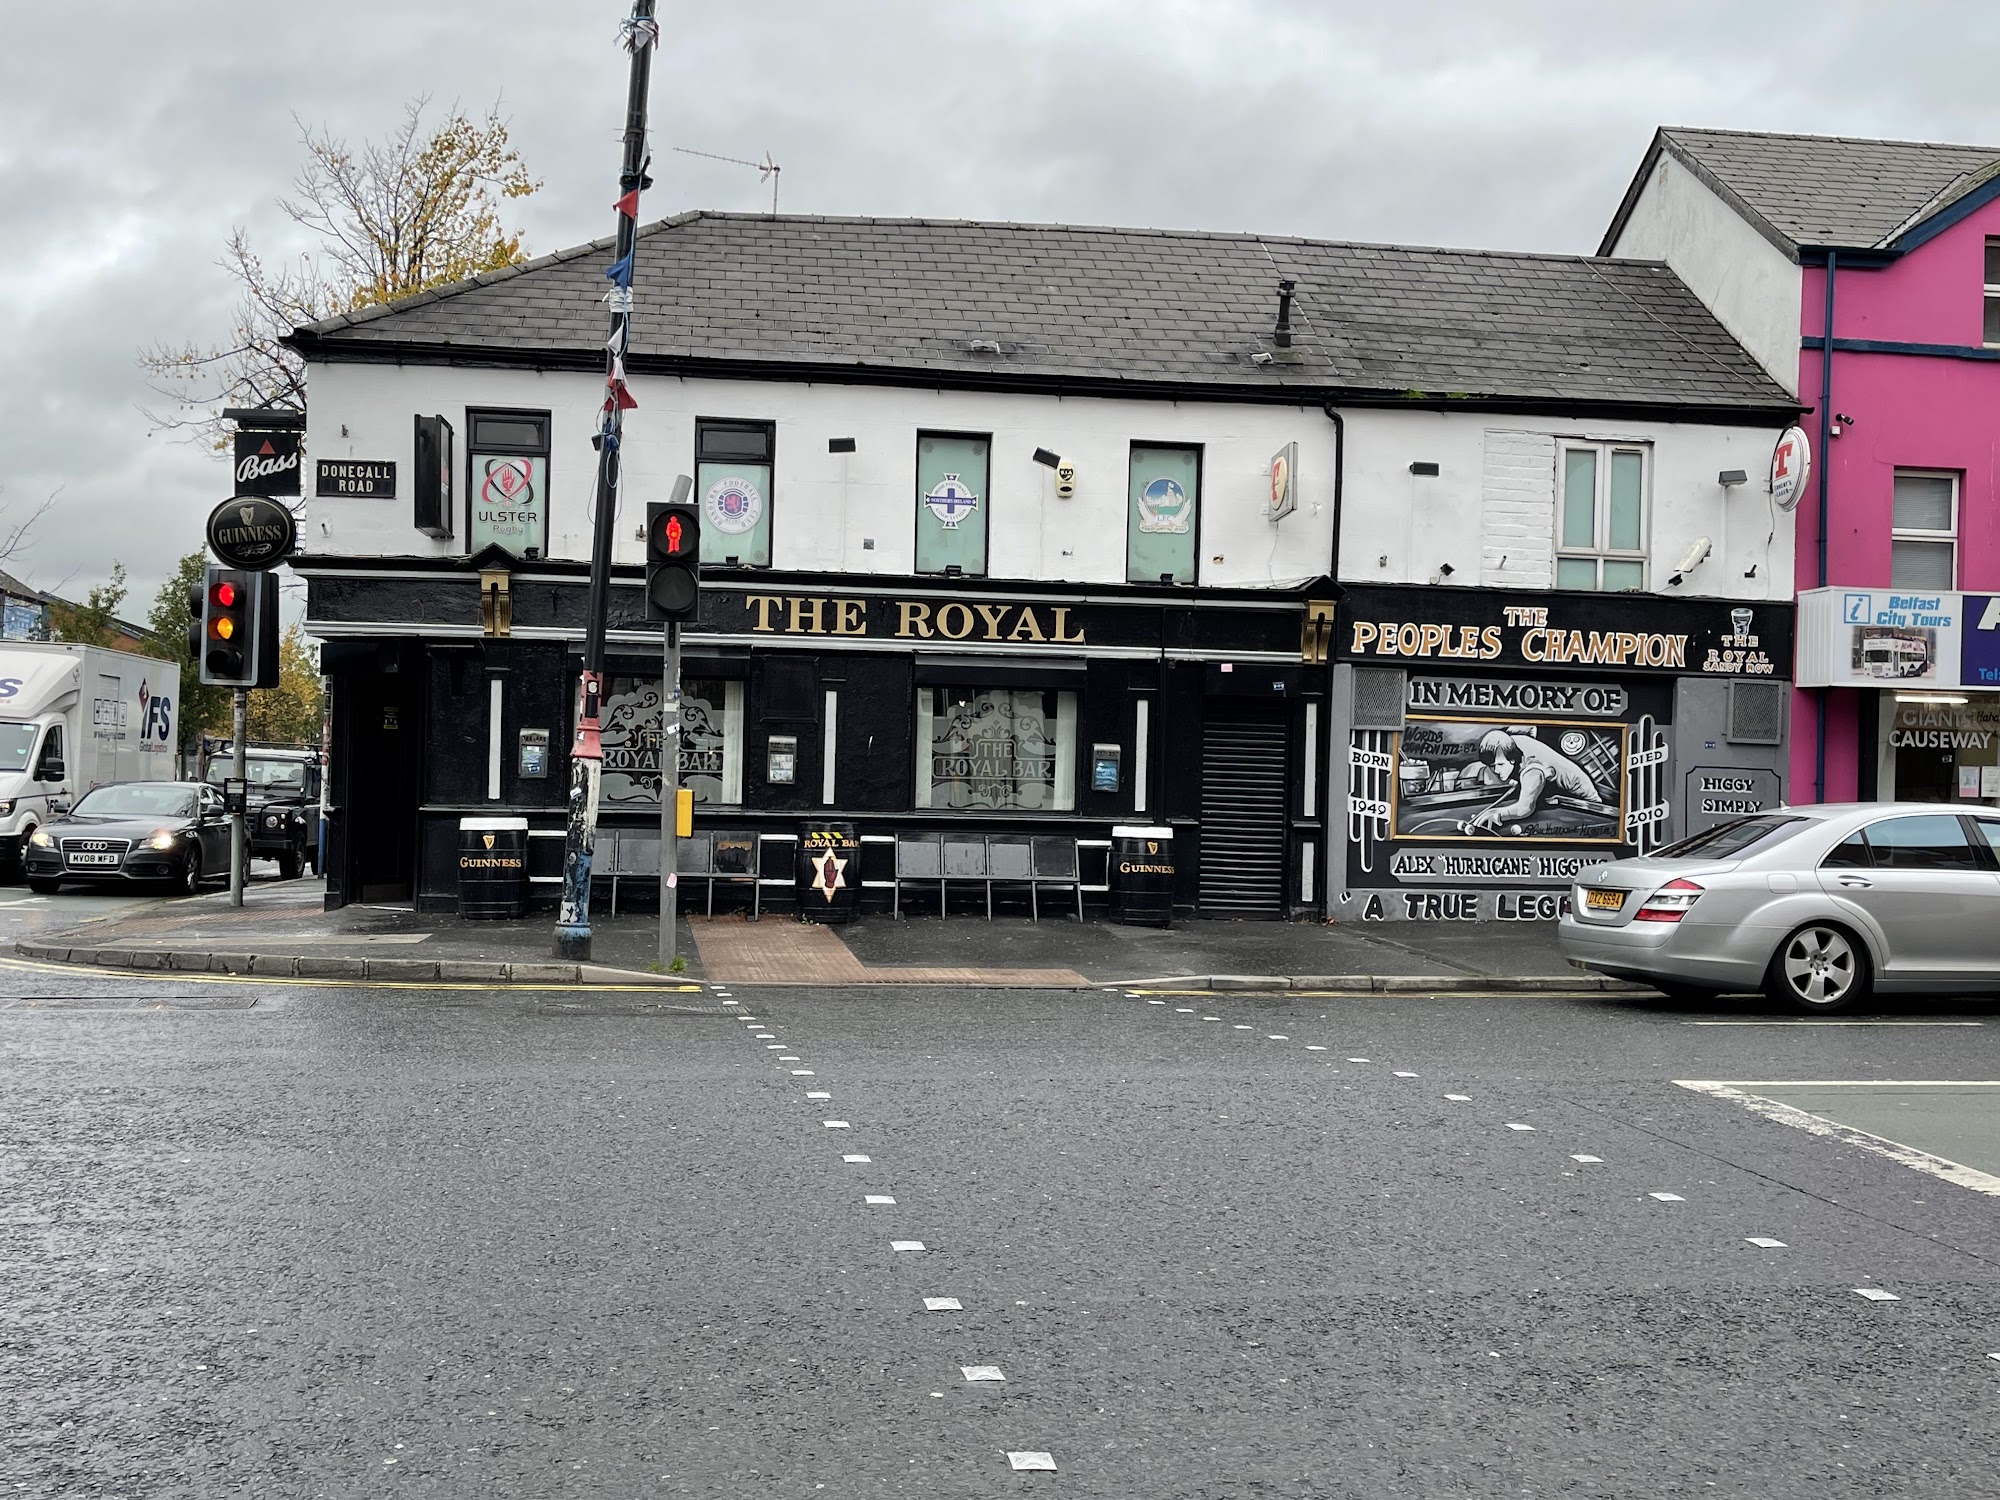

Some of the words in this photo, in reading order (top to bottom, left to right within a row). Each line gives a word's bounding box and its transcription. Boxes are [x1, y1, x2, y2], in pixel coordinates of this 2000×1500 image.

[237, 452, 298, 482] Bass
[1775, 443, 1793, 478] T
[321, 464, 391, 479] DONEGALL
[338, 480, 374, 492] ROAD
[479, 511, 537, 522] ULSTER
[219, 525, 282, 545] GUINNESS
[493, 524, 523, 535] Rugby
[1888, 596, 1941, 610] Belfast
[746, 595, 867, 635] THE
[894, 601, 1085, 643] ROYAL
[1503, 606, 1549, 627] THE
[1877, 610, 1907, 628] City
[1912, 612, 1952, 627] Tours
[1351, 621, 1503, 659] PEOPLES
[1521, 627, 1688, 667] CHAMPION
[1721, 635, 1759, 647] THE
[1707, 649, 1769, 663] ROYAL
[1702, 661, 1743, 673] SANDY
[1745, 664, 1774, 674] ROW
[1409, 681, 1442, 706] IN
[1444, 682, 1582, 711] MEMORY
[1581, 688, 1621, 714] OF
[1888, 730, 1992, 749] CAUSEWAY
[981, 743, 1013, 758] THE
[1352, 752, 1389, 767] BORN
[1631, 751, 1663, 766] DIED
[942, 760, 1007, 776] ROYAL
[1013, 761, 1051, 778] BAR
[1700, 777, 1755, 793] HIGGY
[1352, 800, 1387, 815] 1949
[1702, 798, 1763, 815] SIMPLY
[1628, 808, 1664, 825] 2010
[804, 838, 839, 848] ROYAL
[73, 854, 95, 863] MV08
[460, 857, 521, 868] GUINNESS
[1391, 856, 1437, 875] ALEX
[1120, 862, 1175, 874] GUINNESS
[1403, 893, 1479, 921] TRUE
